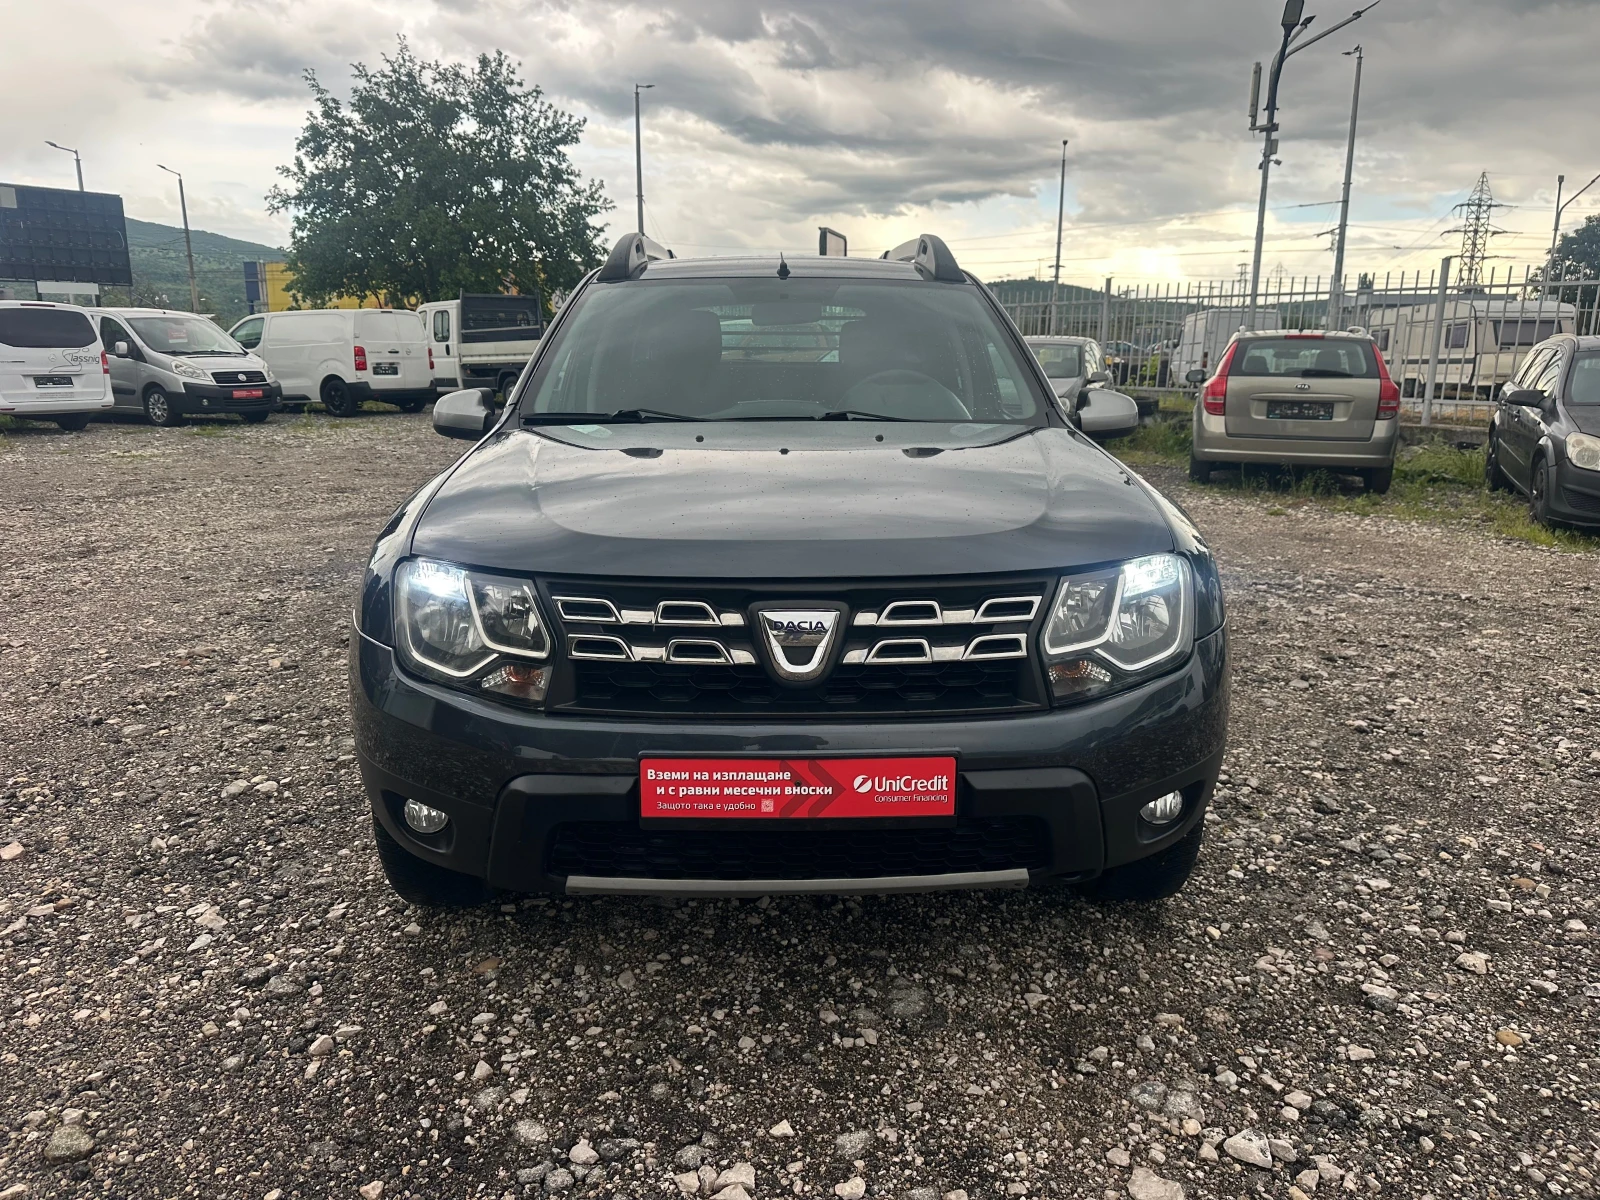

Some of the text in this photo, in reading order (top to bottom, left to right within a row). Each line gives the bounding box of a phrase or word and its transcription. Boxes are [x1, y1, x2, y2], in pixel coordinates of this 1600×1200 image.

[773, 621, 826, 631] DACIA
[647, 769, 791, 782] Вземи на изплащане
[874, 775, 948, 792] UniCredit
[656, 786, 833, 798] и с равни месечни вноски
[874, 794, 948, 803] Consumer Financing
[656, 801, 691, 810] Защото
[723, 801, 756, 811] удобно
